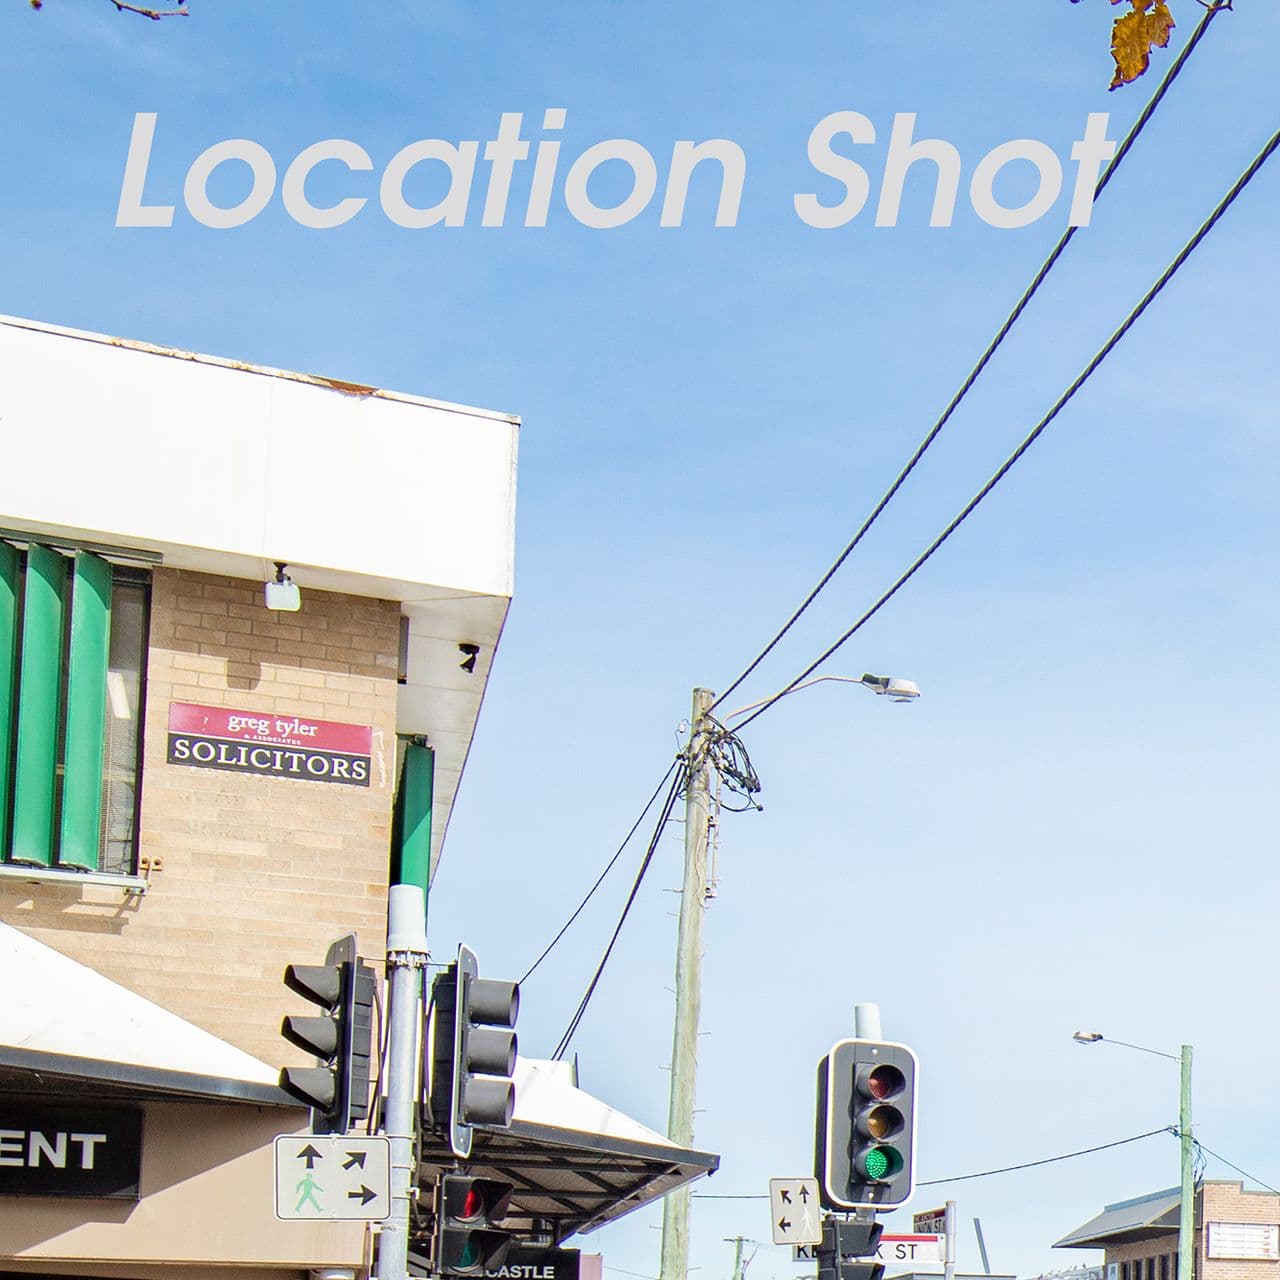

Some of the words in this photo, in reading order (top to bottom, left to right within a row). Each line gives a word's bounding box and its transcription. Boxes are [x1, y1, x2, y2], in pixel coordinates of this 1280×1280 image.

[227, 714, 271, 736] greg
[275, 718, 319, 738] tyler
[174, 738, 367, 780] SOLICITORS
[0, 1128, 107, 1170] ENT
[895, 1243, 918, 1260] ST
[484, 1265, 555, 1280] CASTLE
